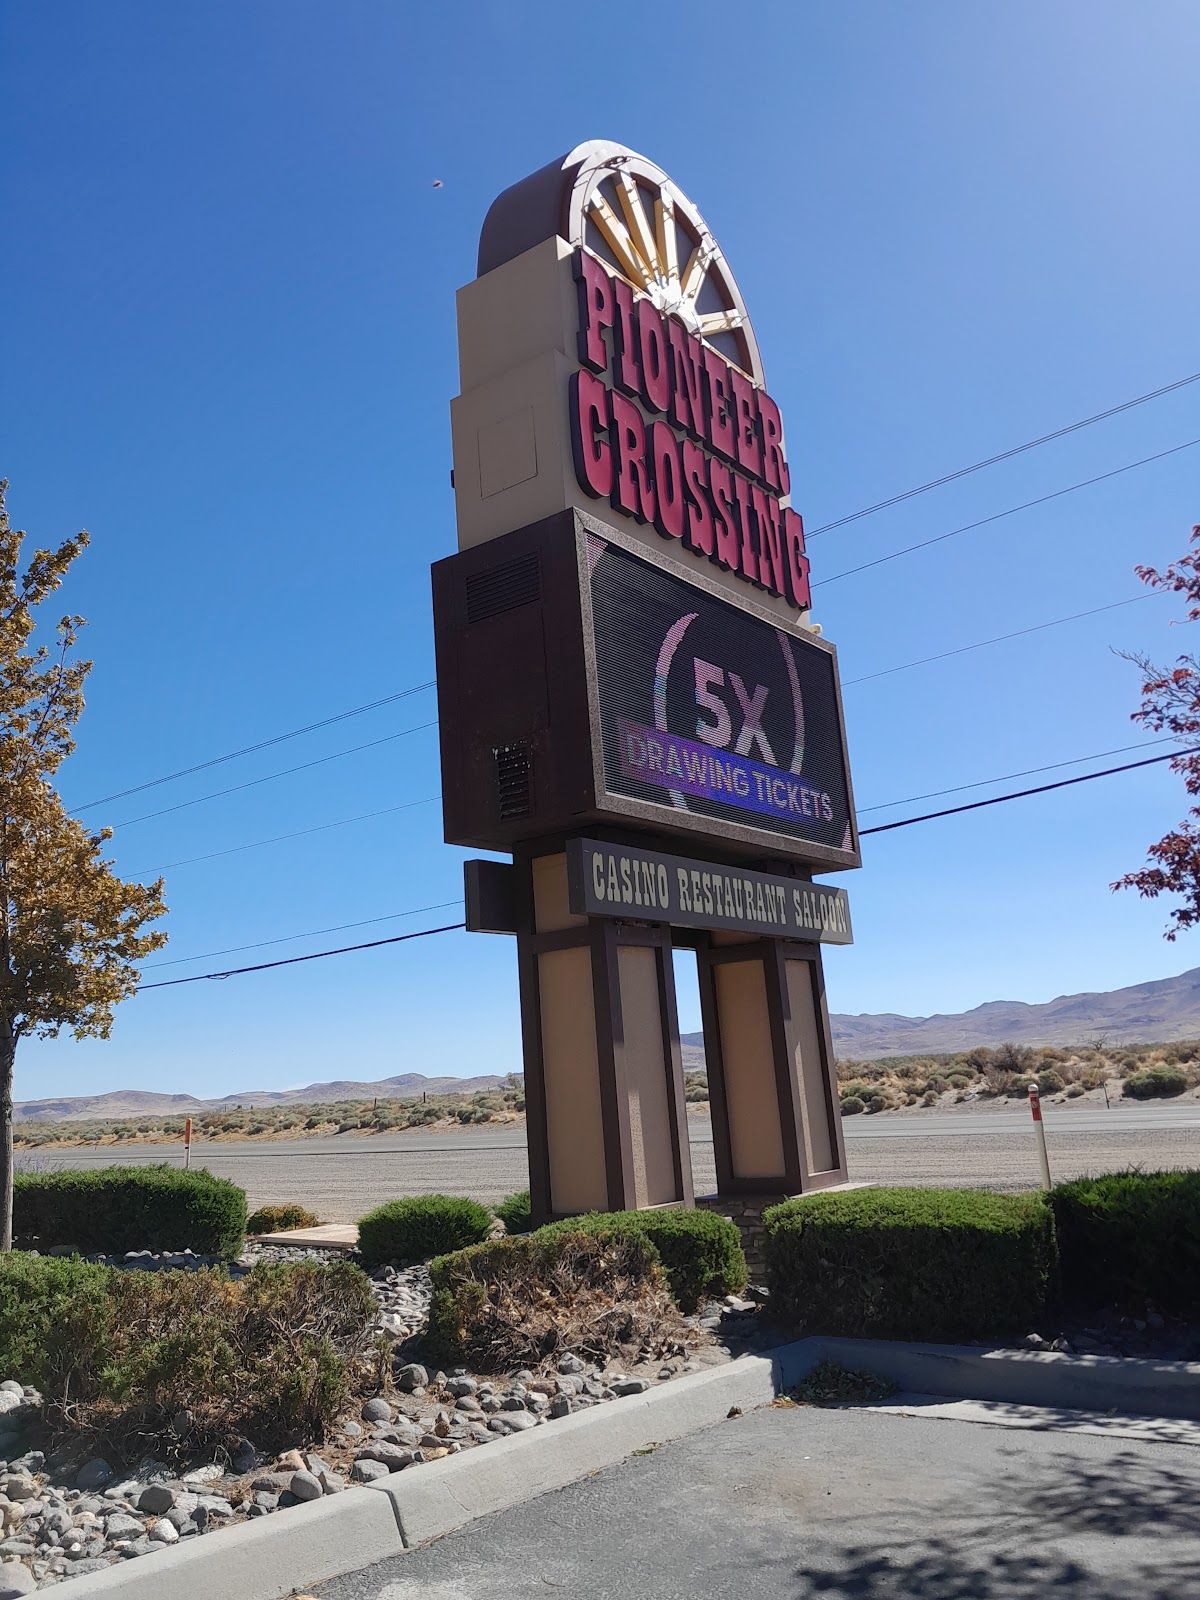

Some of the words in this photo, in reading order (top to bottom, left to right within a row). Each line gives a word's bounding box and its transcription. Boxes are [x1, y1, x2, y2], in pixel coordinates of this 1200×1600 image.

[573, 247, 791, 498] PIONEER
[570, 368, 812, 611] CROSSING
[693, 656, 778, 766] 5X
[626, 733, 750, 797] DRAWING
[752, 771, 834, 822] TICKETS
[592, 851, 670, 910] CASINO
[677, 867, 787, 925] RESTAURANT
[792, 888, 848, 933] SALOON
